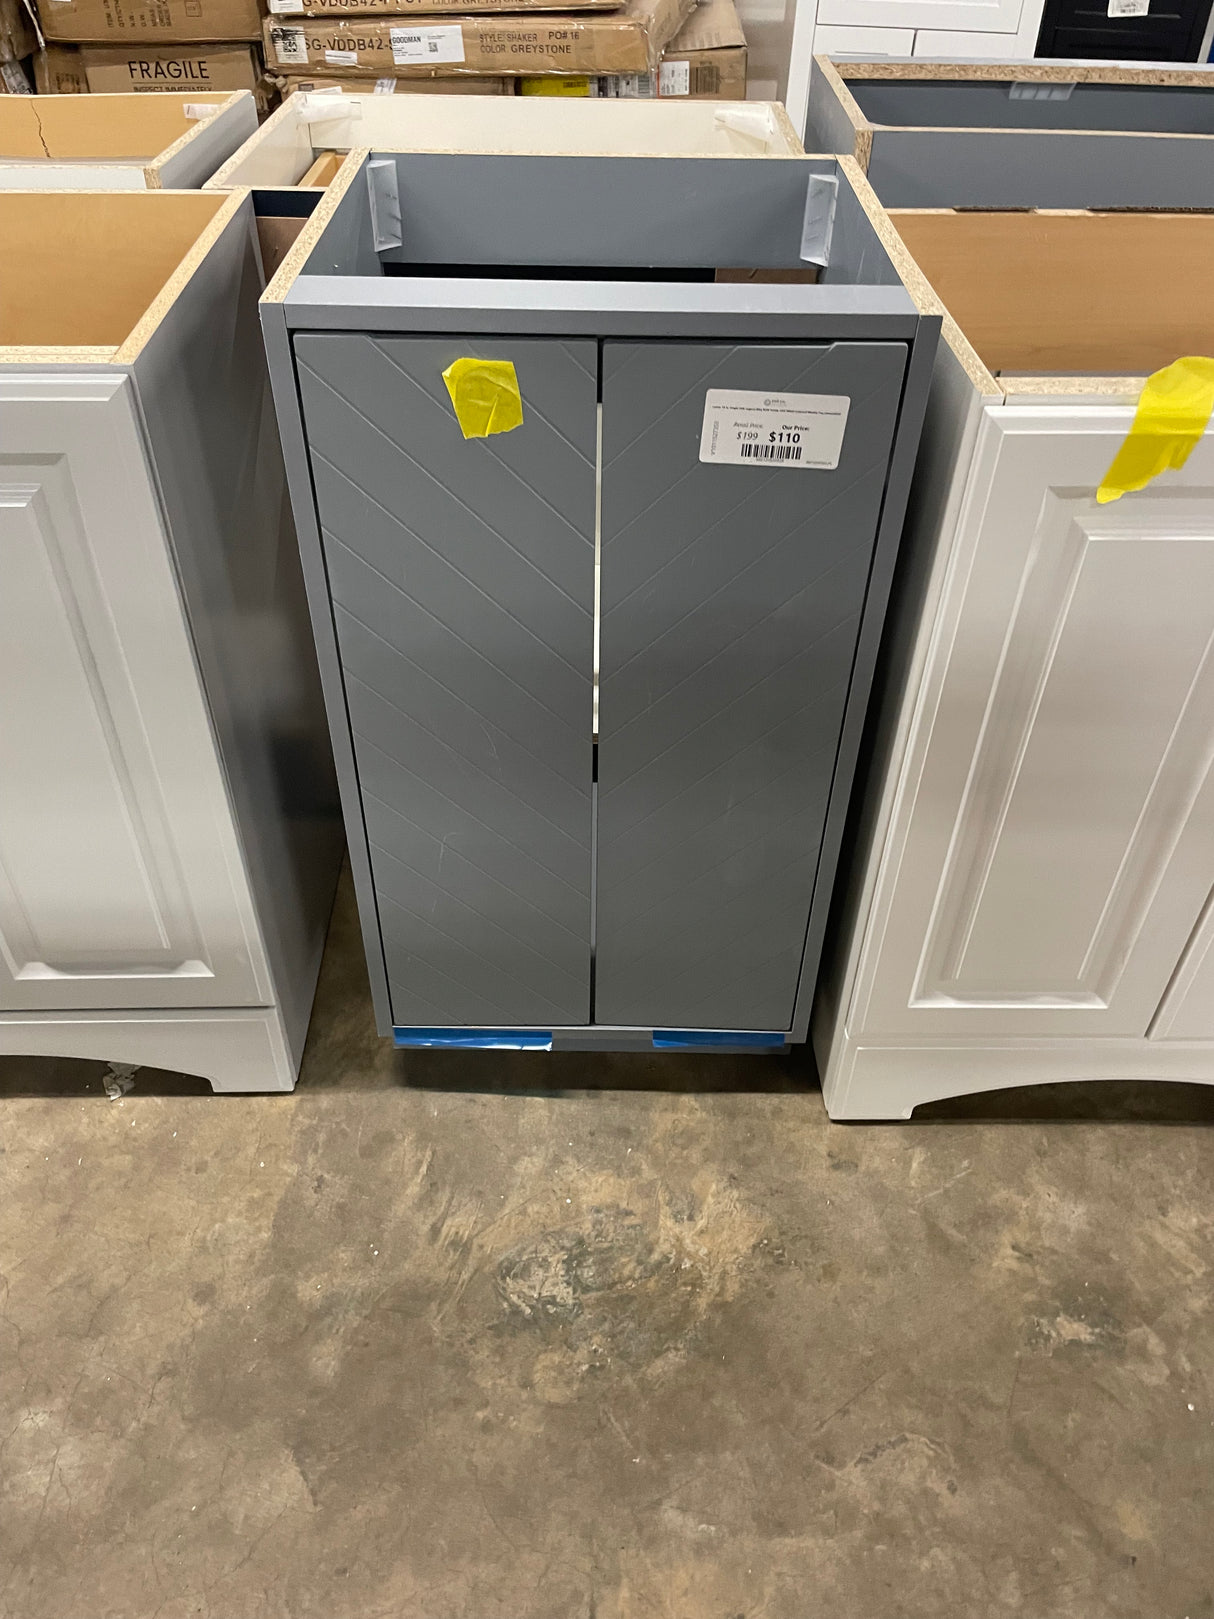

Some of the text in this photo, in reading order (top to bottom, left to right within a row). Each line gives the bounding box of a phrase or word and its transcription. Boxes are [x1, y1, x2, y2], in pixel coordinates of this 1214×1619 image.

[392, 36, 421, 44] GOODMAN
[506, 33, 538, 42] SHAKER
[548, 31, 567, 40] PO#
[511, 44, 572, 54] GREYSTONE
[127, 61, 210, 79] FRAGILE
[736, 431, 801, 444] $199 $110
